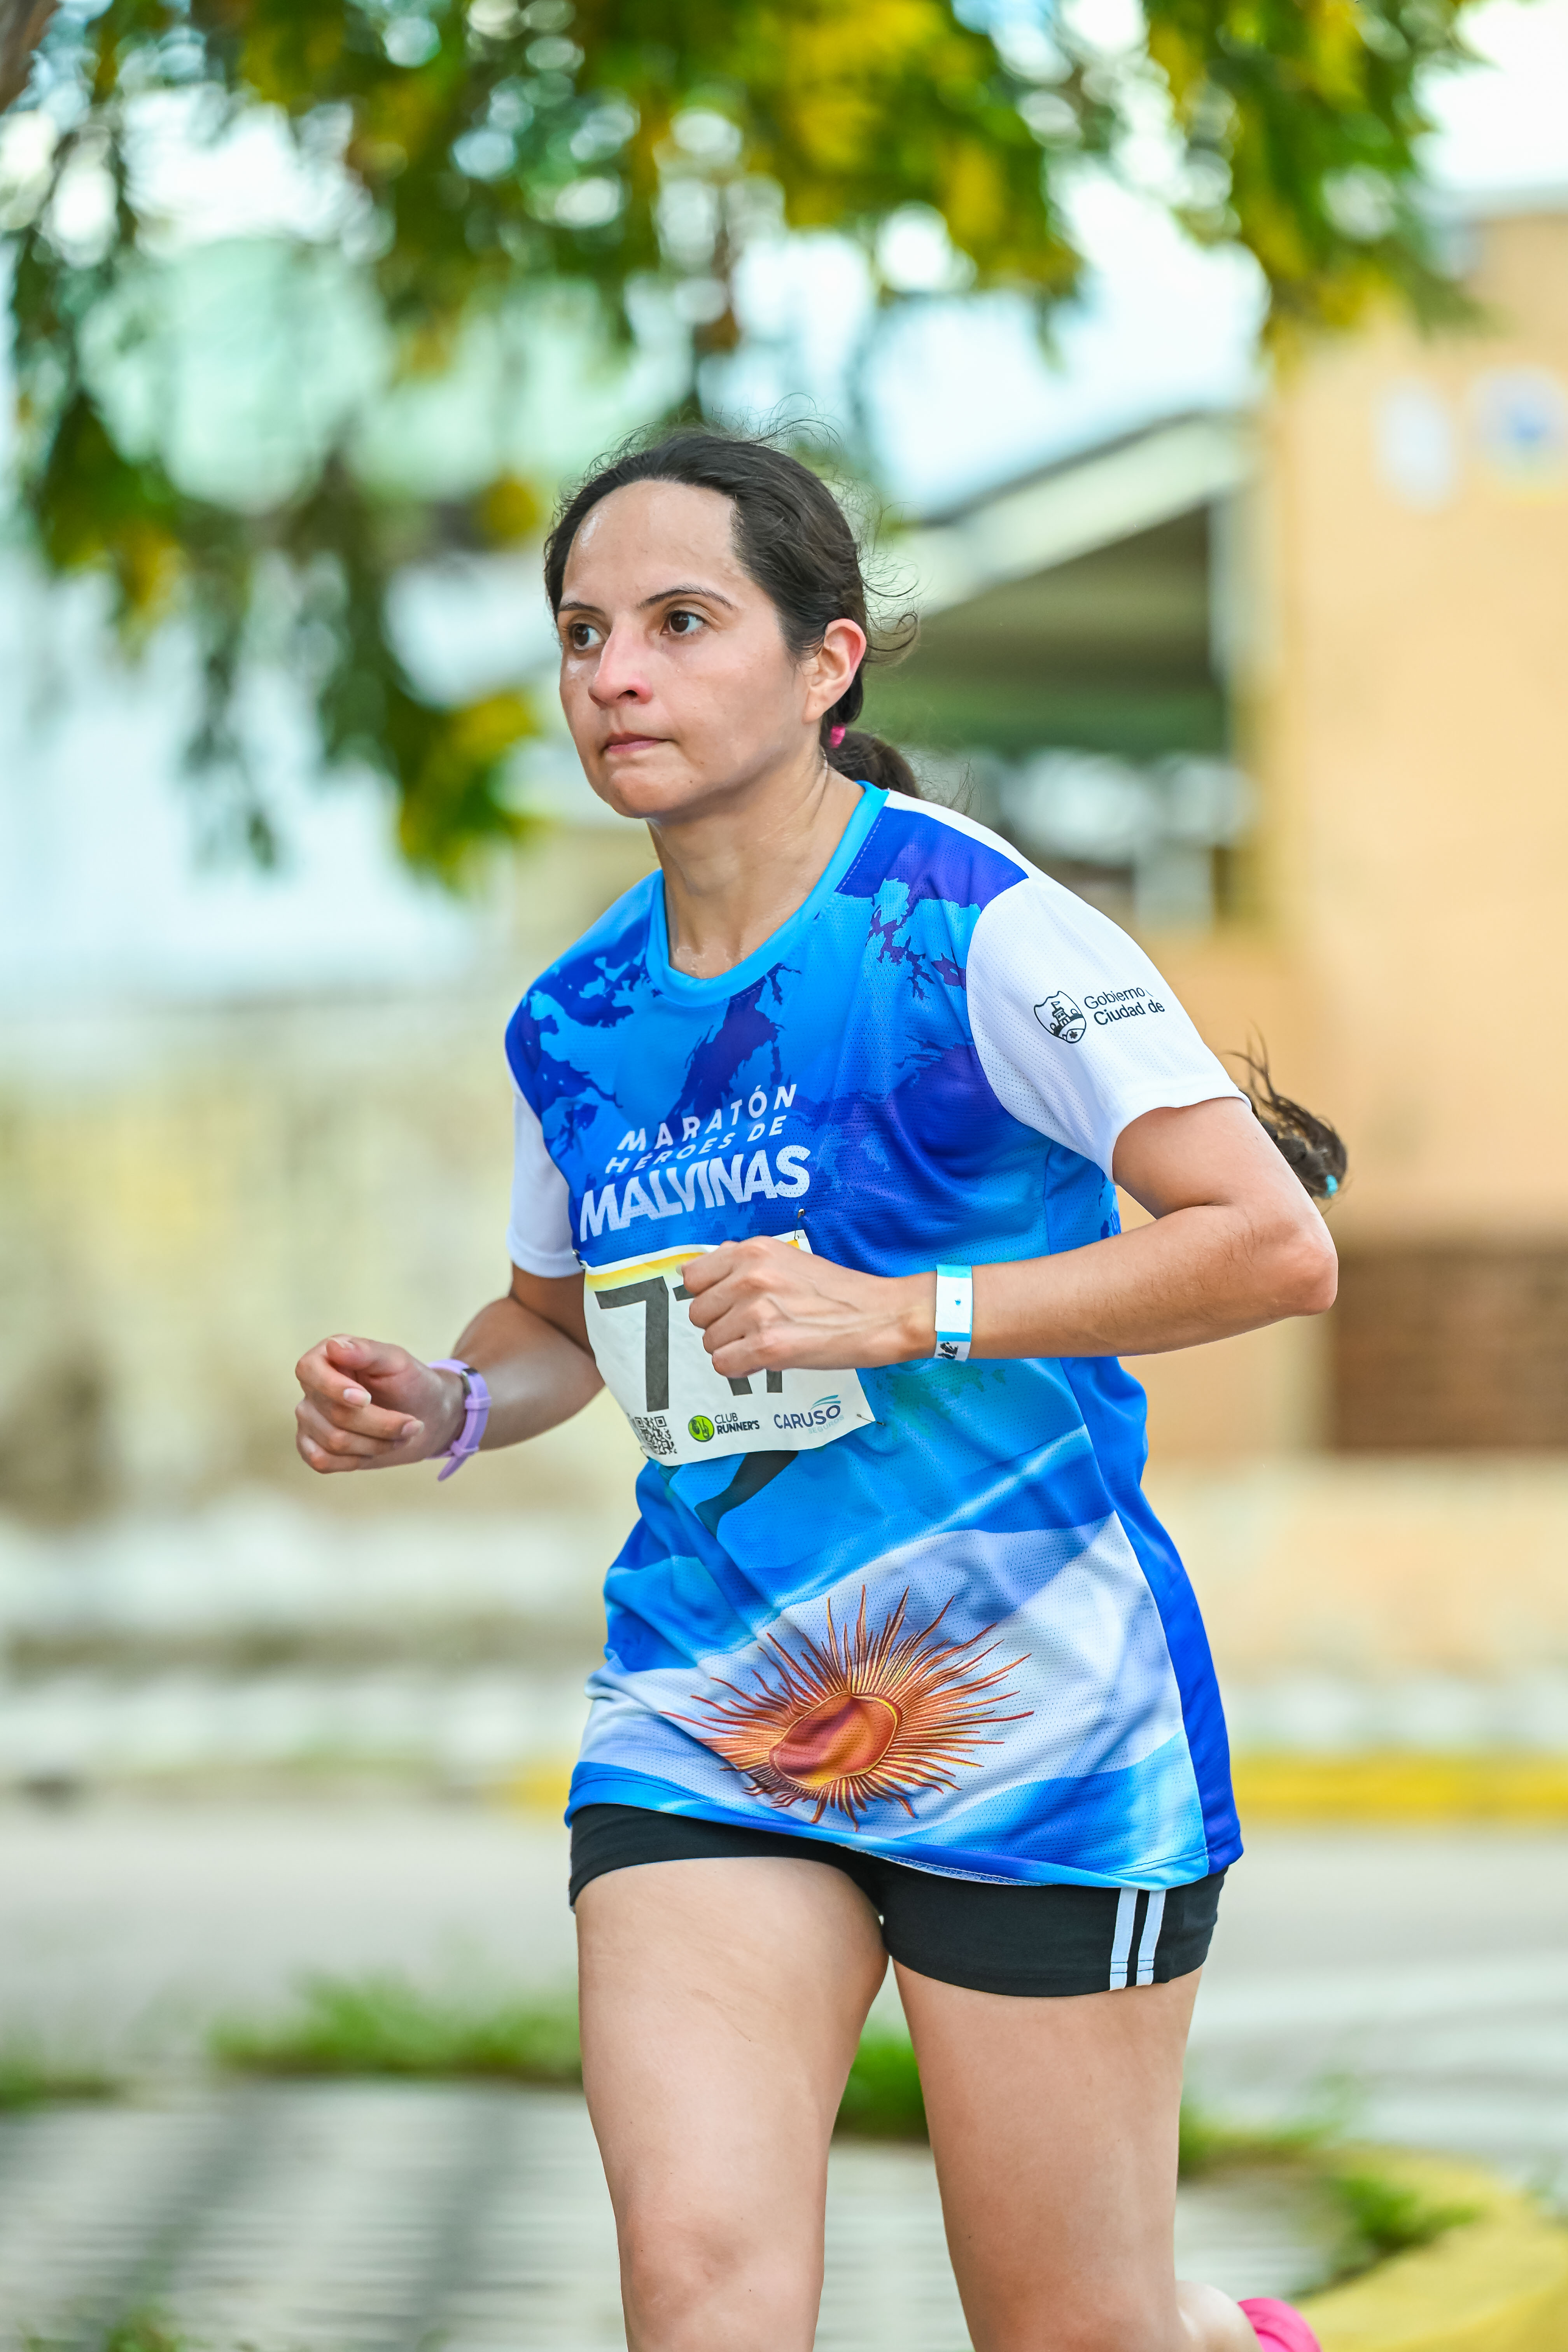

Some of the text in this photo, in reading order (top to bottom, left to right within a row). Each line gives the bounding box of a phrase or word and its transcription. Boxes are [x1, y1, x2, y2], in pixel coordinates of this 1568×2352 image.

[1084, 987, 1145, 1009] Gobierno
[1093, 999, 1166, 1025] Ciudad de
[616, 1083, 797, 1152] MARATÓN
[747, 1115, 787, 1142] DE
[579, 1144, 811, 1242] MALVINAS
[714, 1412, 738, 1424] CLUB
[716, 1420, 760, 1435] RUNNER'S
[773, 1405, 841, 1429] CARUSO
[808, 1414, 844, 1434] SEGUROS
